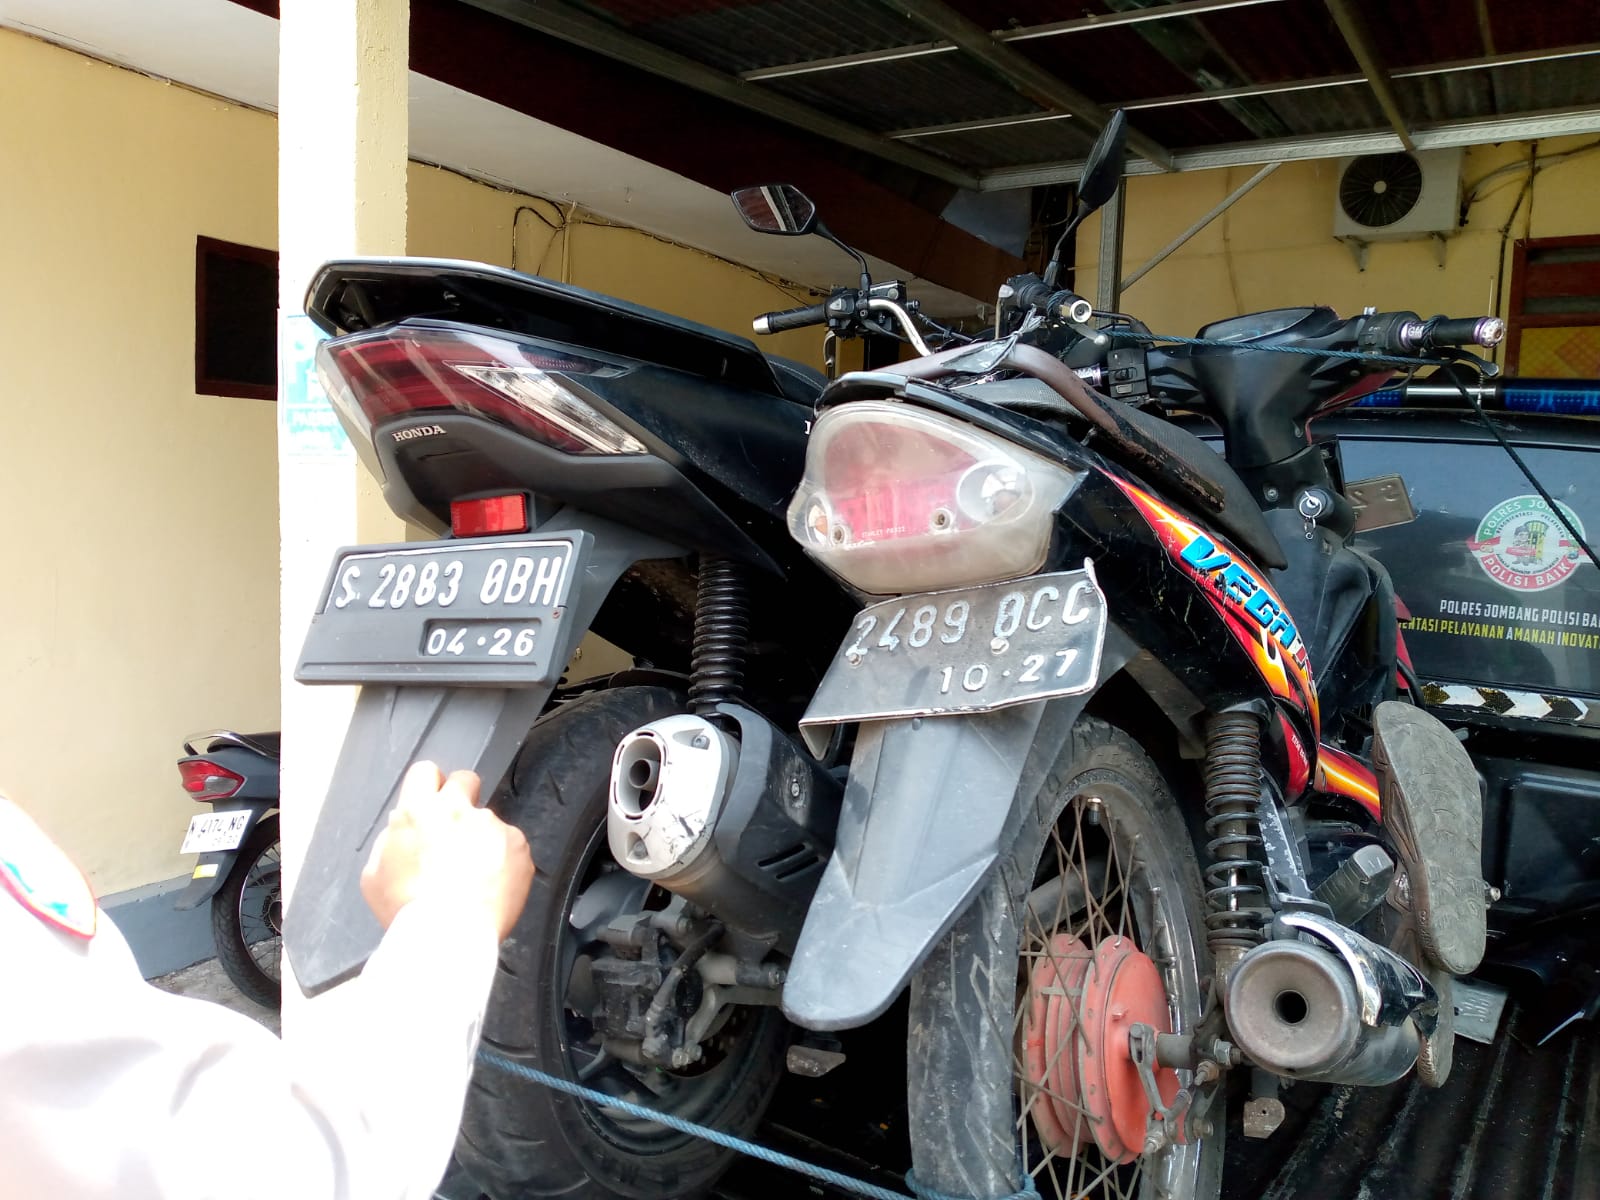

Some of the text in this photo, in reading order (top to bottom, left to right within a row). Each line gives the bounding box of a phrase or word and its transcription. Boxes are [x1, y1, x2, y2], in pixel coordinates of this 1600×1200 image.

[391, 424, 447, 441] HONDA
[1483, 500, 1521, 536] POLRES
[335, 565, 361, 608] S
[368, 560, 464, 609] 2883
[1484, 557, 1529, 587] POLISI
[1535, 562, 1571, 586] BAIK
[1180, 535, 1297, 650] VEGA
[845, 600, 970, 657] 2489
[1440, 599, 1482, 617] POLRES
[1484, 603, 1539, 623] JOMBANG
[1541, 608, 1580, 627] POLISI
[1441, 620, 1505, 640] PELAYANAN
[1506, 626, 1556, 646] AMANAH
